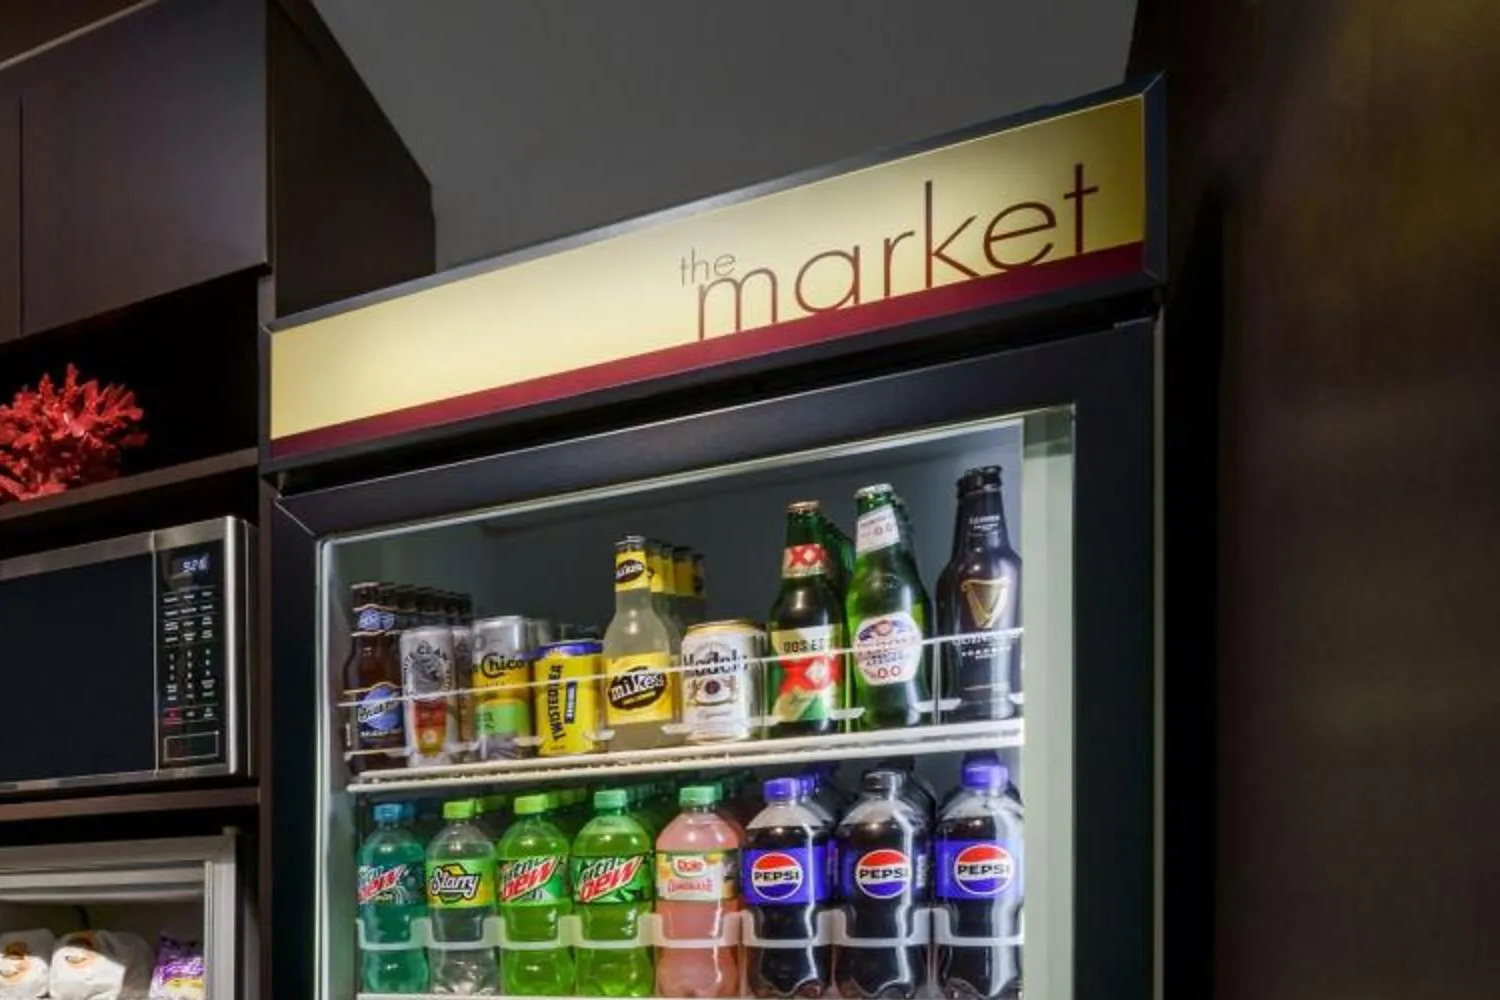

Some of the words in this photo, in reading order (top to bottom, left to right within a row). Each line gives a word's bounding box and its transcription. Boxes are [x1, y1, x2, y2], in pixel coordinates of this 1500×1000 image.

[680, 247, 736, 287] the
[699, 163, 1098, 341] market
[549, 689, 565, 741] TWISTED
[430, 867, 478, 897] Starry
[754, 870, 800, 881] PEPSI
[859, 867, 909, 880] PEPSI
[957, 863, 1012, 876] PEPSI
